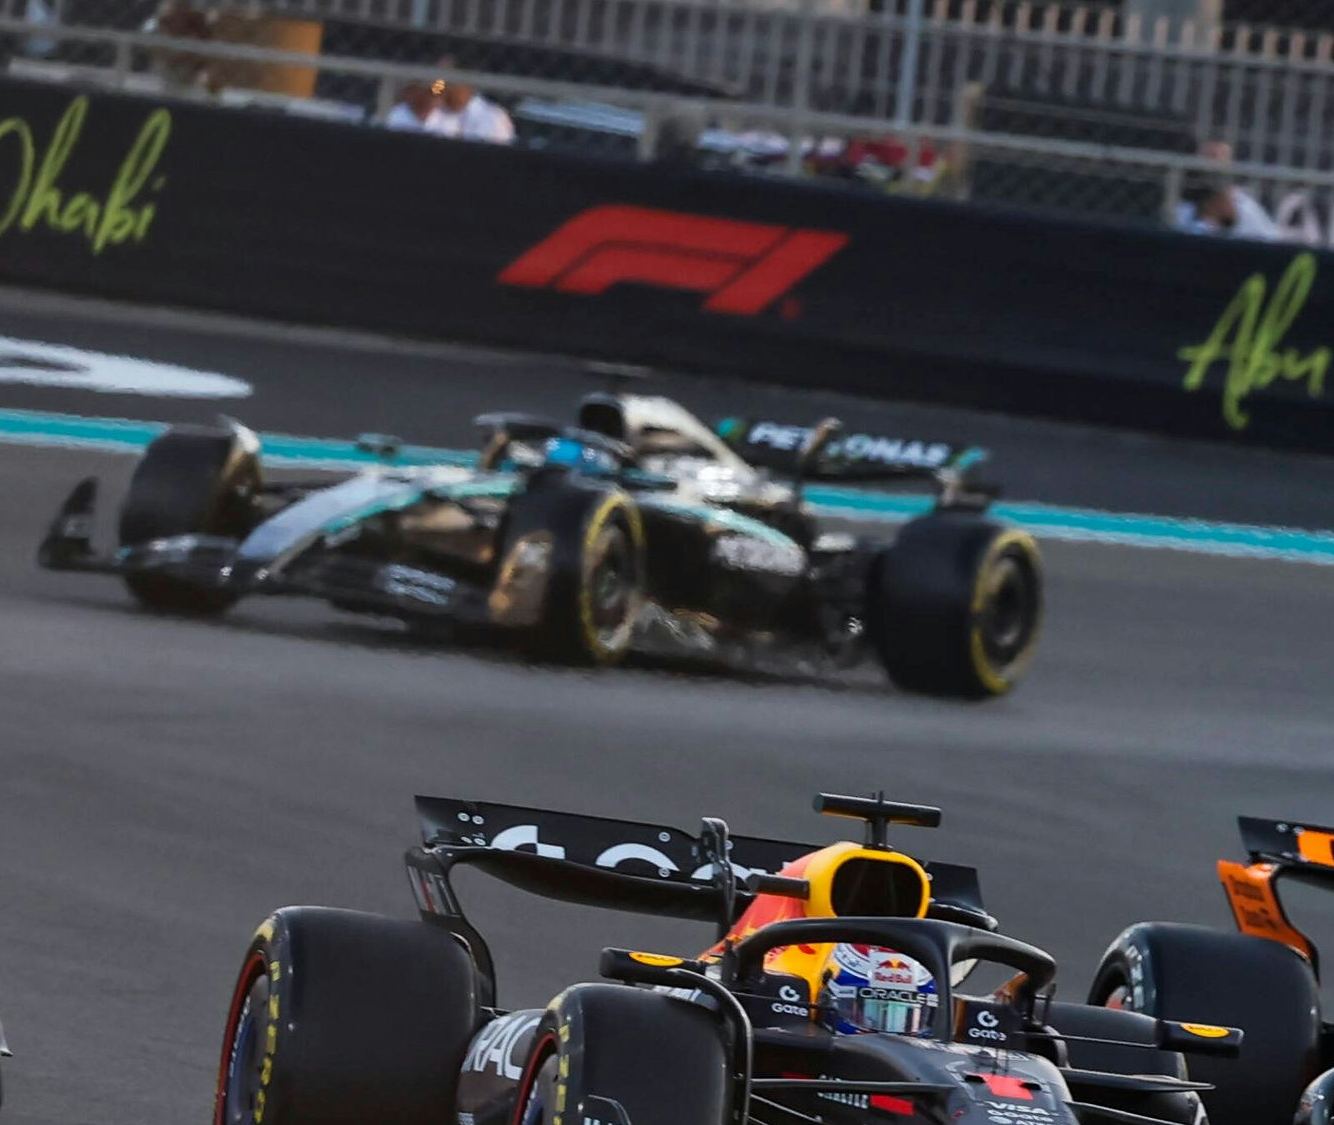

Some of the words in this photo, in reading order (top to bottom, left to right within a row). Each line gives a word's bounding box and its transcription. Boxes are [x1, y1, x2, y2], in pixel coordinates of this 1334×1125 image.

[1178, 252, 1333, 431] Abu
[858, 986, 928, 1005] ORACLE
[770, 1002, 809, 1017] Gate
[985, 1100, 1050, 1116] VISA
